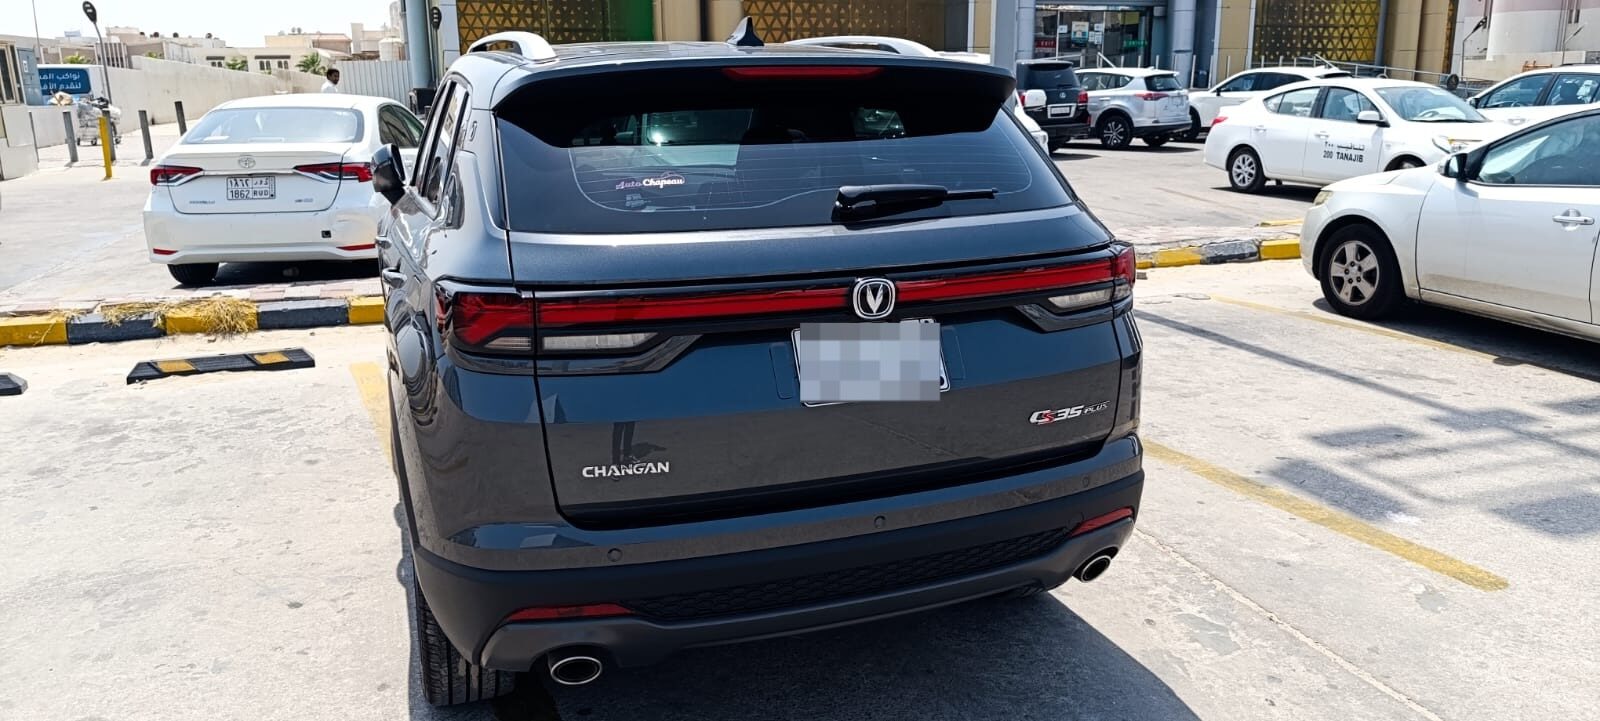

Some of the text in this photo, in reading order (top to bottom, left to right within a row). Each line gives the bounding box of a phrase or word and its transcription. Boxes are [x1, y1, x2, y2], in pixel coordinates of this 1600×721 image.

[1323, 150, 1364, 162] 200 TANAJIB
[616, 178, 683, 189] Auto Chapeau
[230, 190, 250, 199] 1862
[1084, 401, 1111, 414] PLUS
[582, 461, 670, 478] CHANGAN
